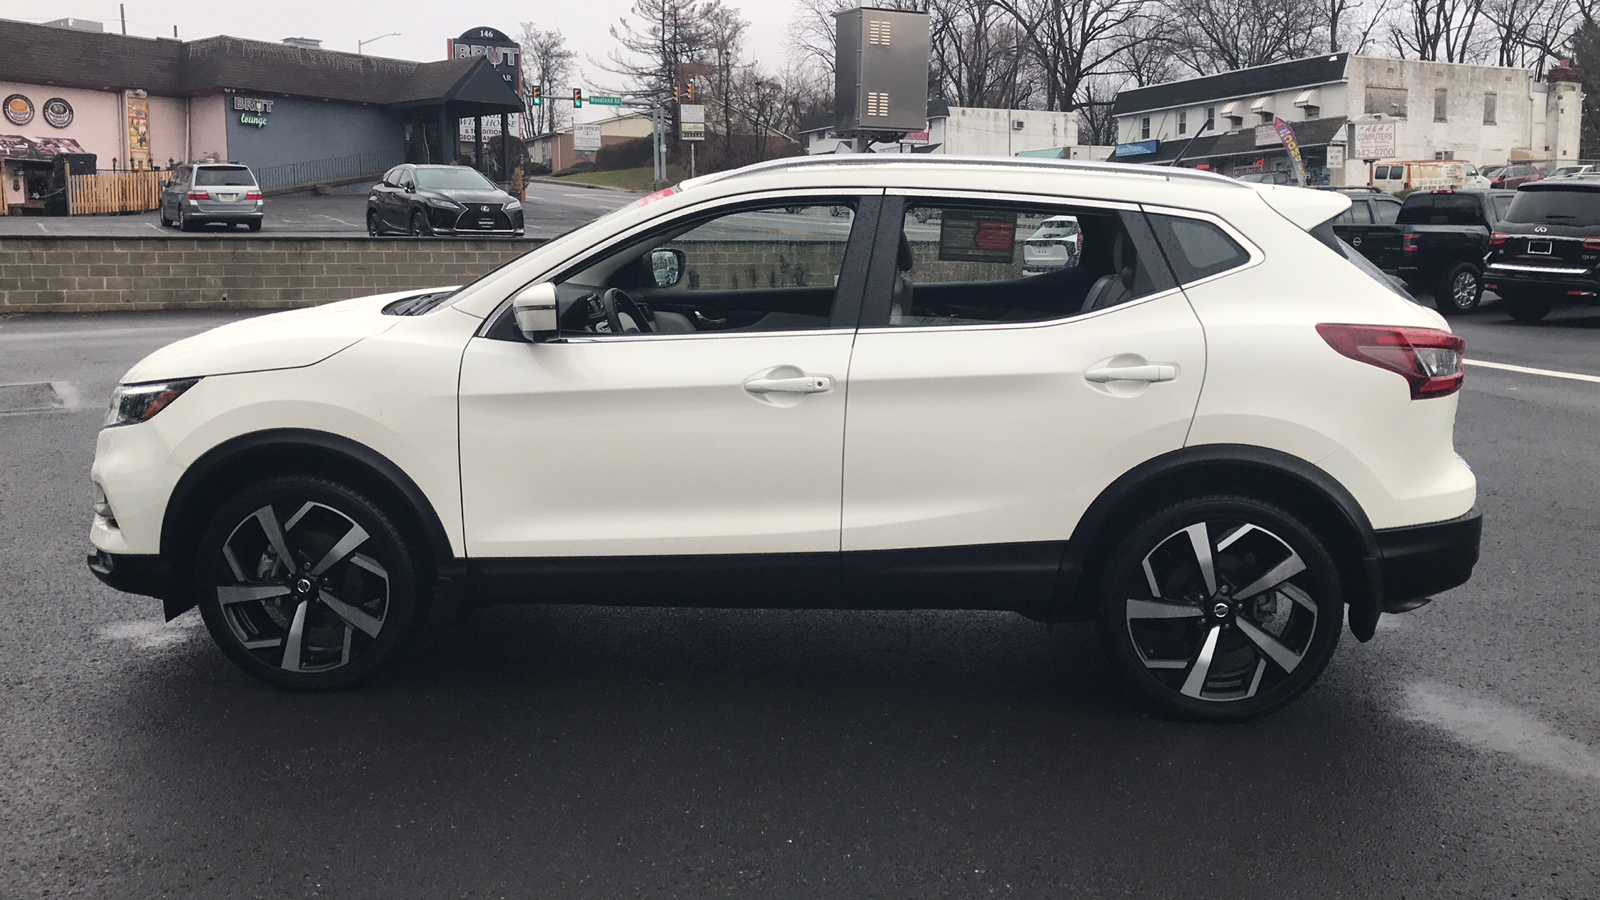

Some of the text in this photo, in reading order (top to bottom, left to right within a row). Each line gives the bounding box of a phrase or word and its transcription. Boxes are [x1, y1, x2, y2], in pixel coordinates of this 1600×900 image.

[480, 30, 494, 38] 146
[234, 97, 274, 113] BRUT
[241, 113, 267, 128] lounge
[1357, 133, 1393, 141] COMPUTERS
[1356, 148, 1394, 158] 942-9700
